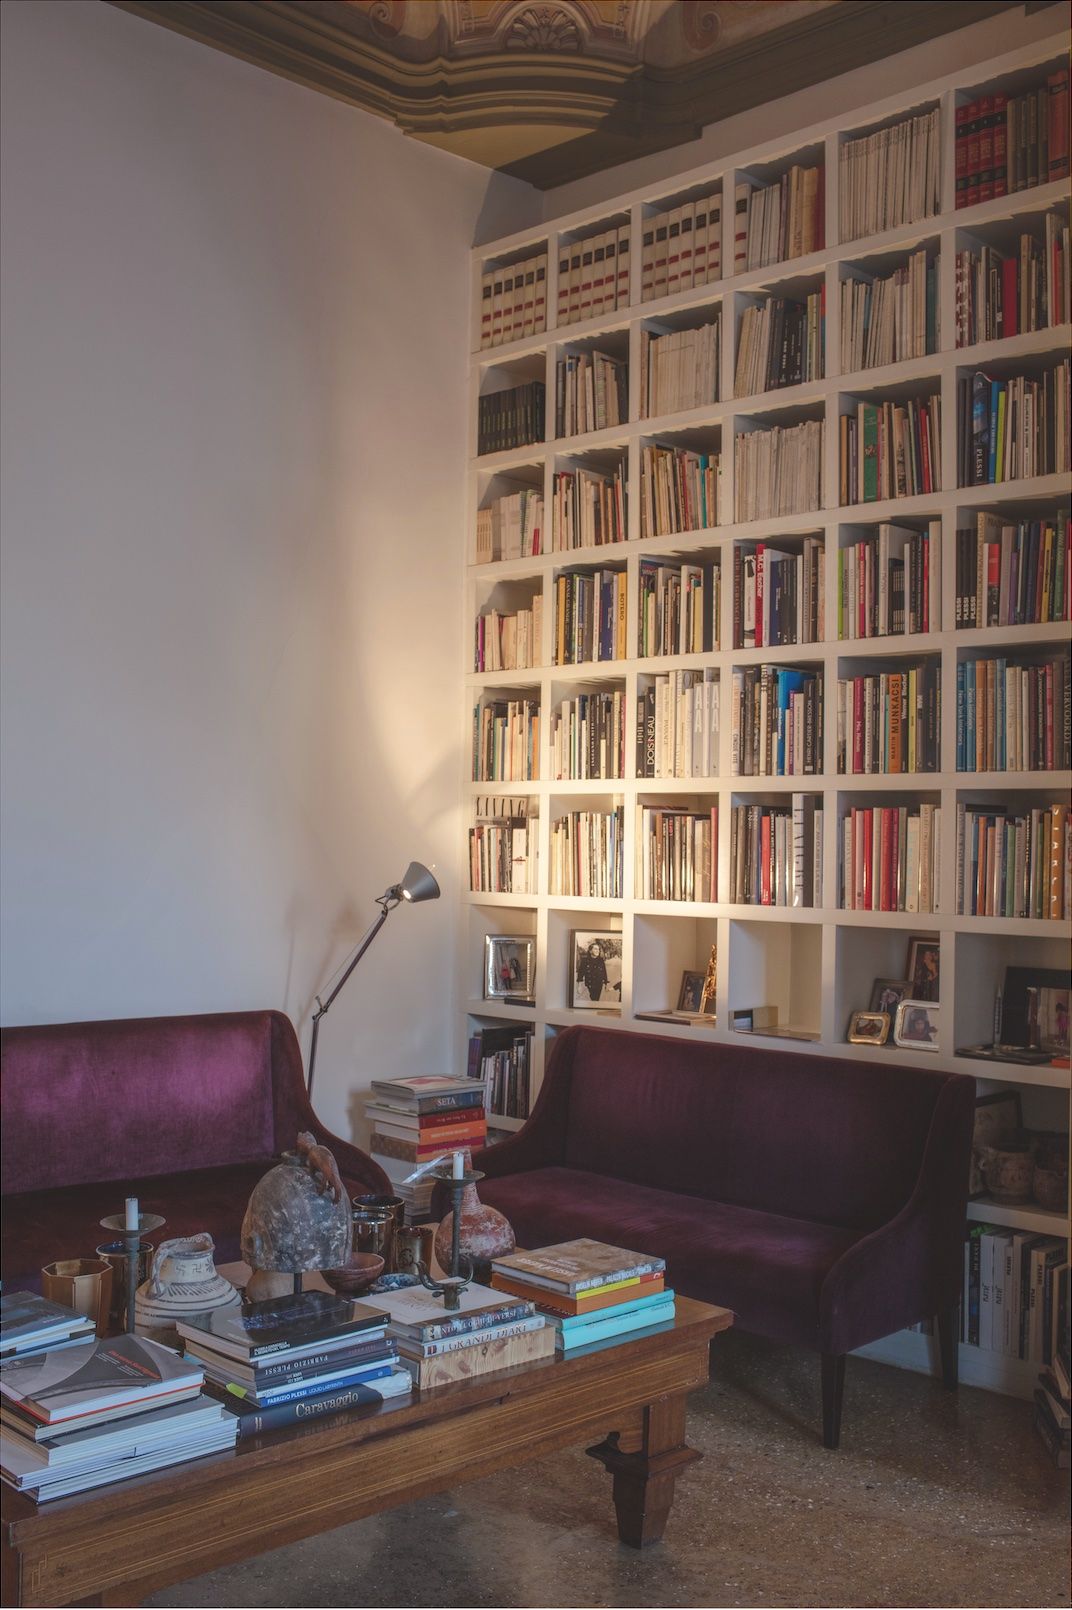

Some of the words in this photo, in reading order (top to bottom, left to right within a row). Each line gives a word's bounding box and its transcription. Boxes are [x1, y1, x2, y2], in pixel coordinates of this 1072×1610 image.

[891, 679, 900, 734] MUNKACSI
[1063, 685, 1071, 744] VERVOORDT
[647, 716, 655, 765] DOISNEAU
[437, 1097, 456, 1106] SETA
[265, 1363, 293, 1376] PLESSI
[293, 1355, 328, 1370] FABRIZIO
[267, 1394, 291, 1405] FABRIZIO
[291, 1389, 307, 1401] PLESSI
[296, 1391, 359, 1418] Caravaggio
